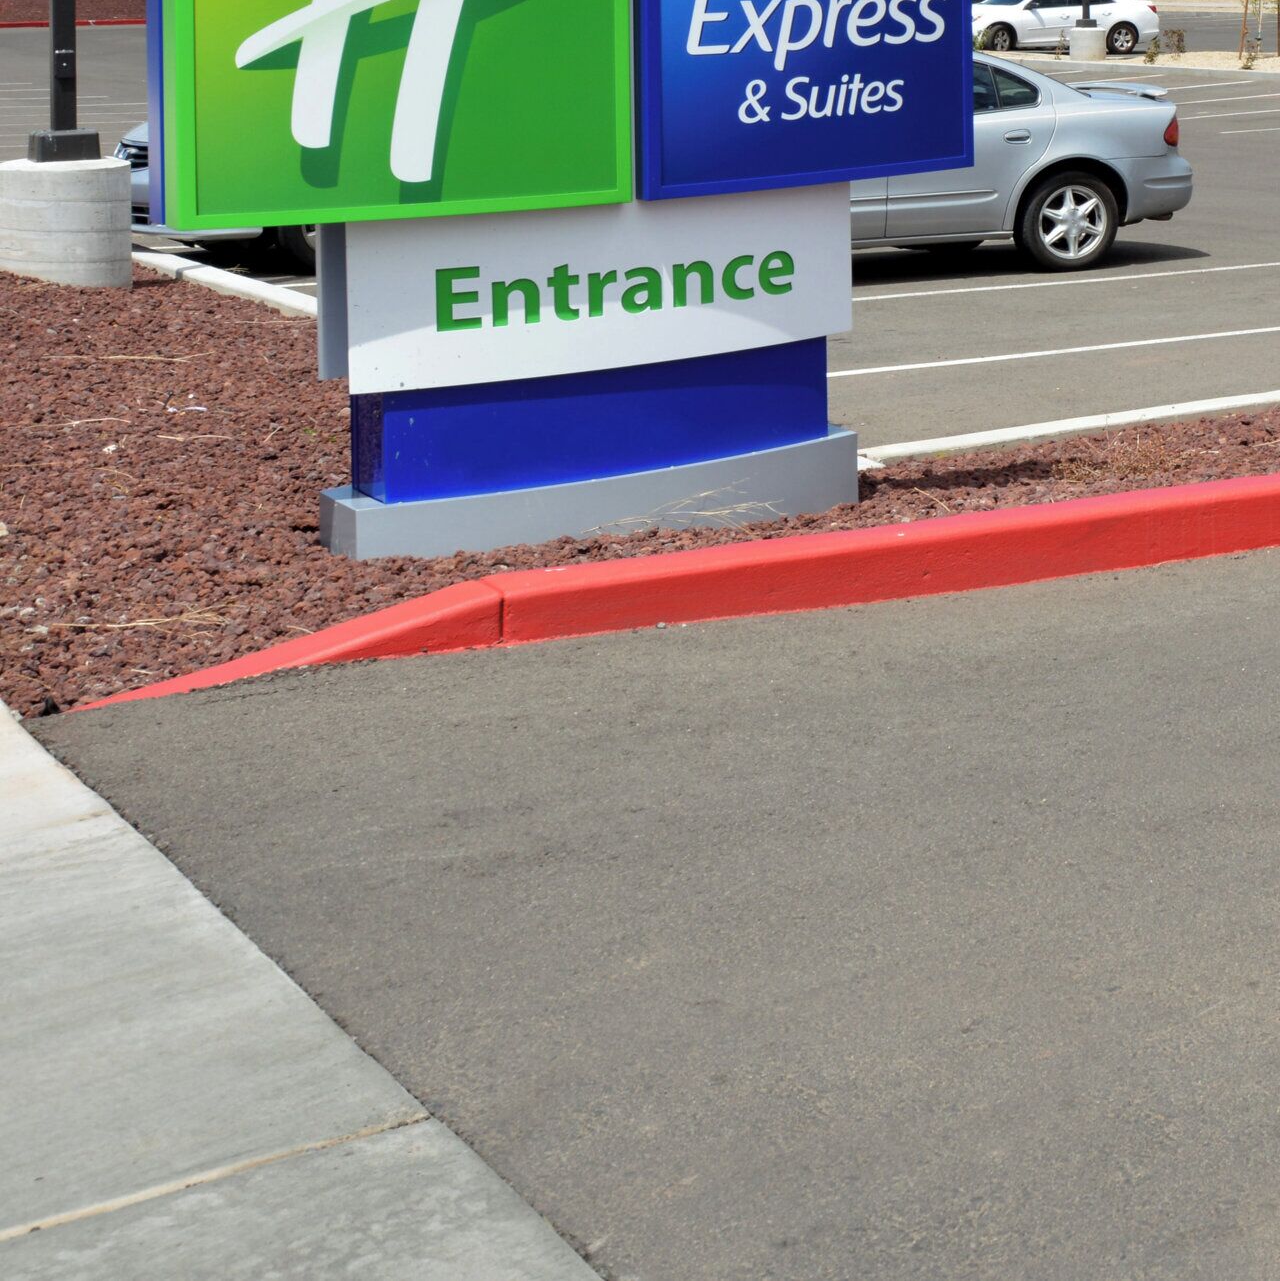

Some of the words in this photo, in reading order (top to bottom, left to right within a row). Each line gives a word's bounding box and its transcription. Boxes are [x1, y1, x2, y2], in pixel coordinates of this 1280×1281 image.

[737, 79, 771, 124] &
[780, 73, 905, 121] Suites
[433, 248, 795, 332] Entrance
